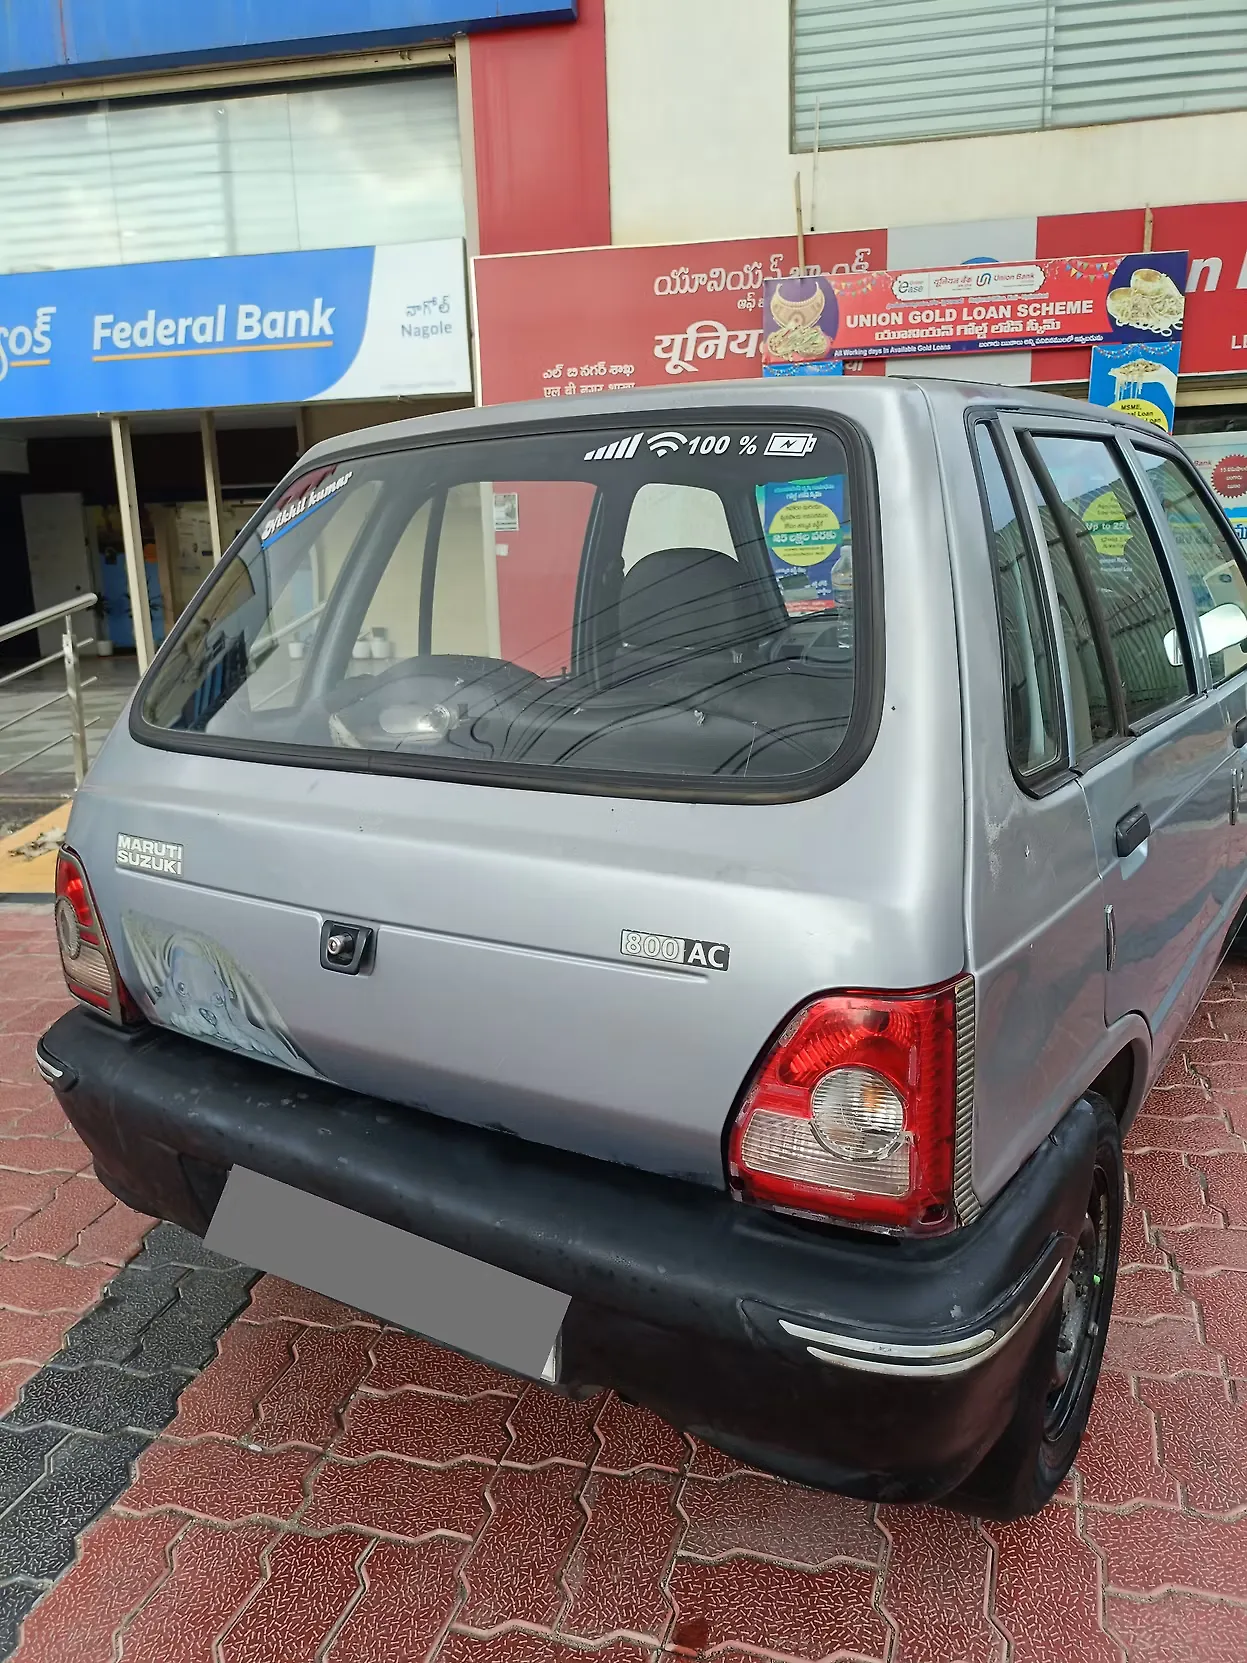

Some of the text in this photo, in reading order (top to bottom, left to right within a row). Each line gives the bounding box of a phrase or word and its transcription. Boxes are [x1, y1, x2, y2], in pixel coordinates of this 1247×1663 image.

[93, 298, 337, 350] Federal Bank
[846, 300, 1094, 328] UNION GOLD LOAN SCHEME
[401, 320, 453, 339] Nagole
[653, 320, 765, 375] यूनिय
[844, 347, 867, 357] Working
[868, 347, 882, 356] days
[890, 343, 917, 353] Available
[917, 343, 932, 351] Gold
[933, 342, 951, 350] Loans
[688, 435, 758, 455] 100 %
[308, 471, 354, 508] kumar
[1102, 522, 1111, 530] to
[1113, 521, 1125, 530] 25
[118, 835, 182, 860] MARUTI
[117, 850, 182, 875] SUZUKI
[625, 932, 726, 968] 800 AC
